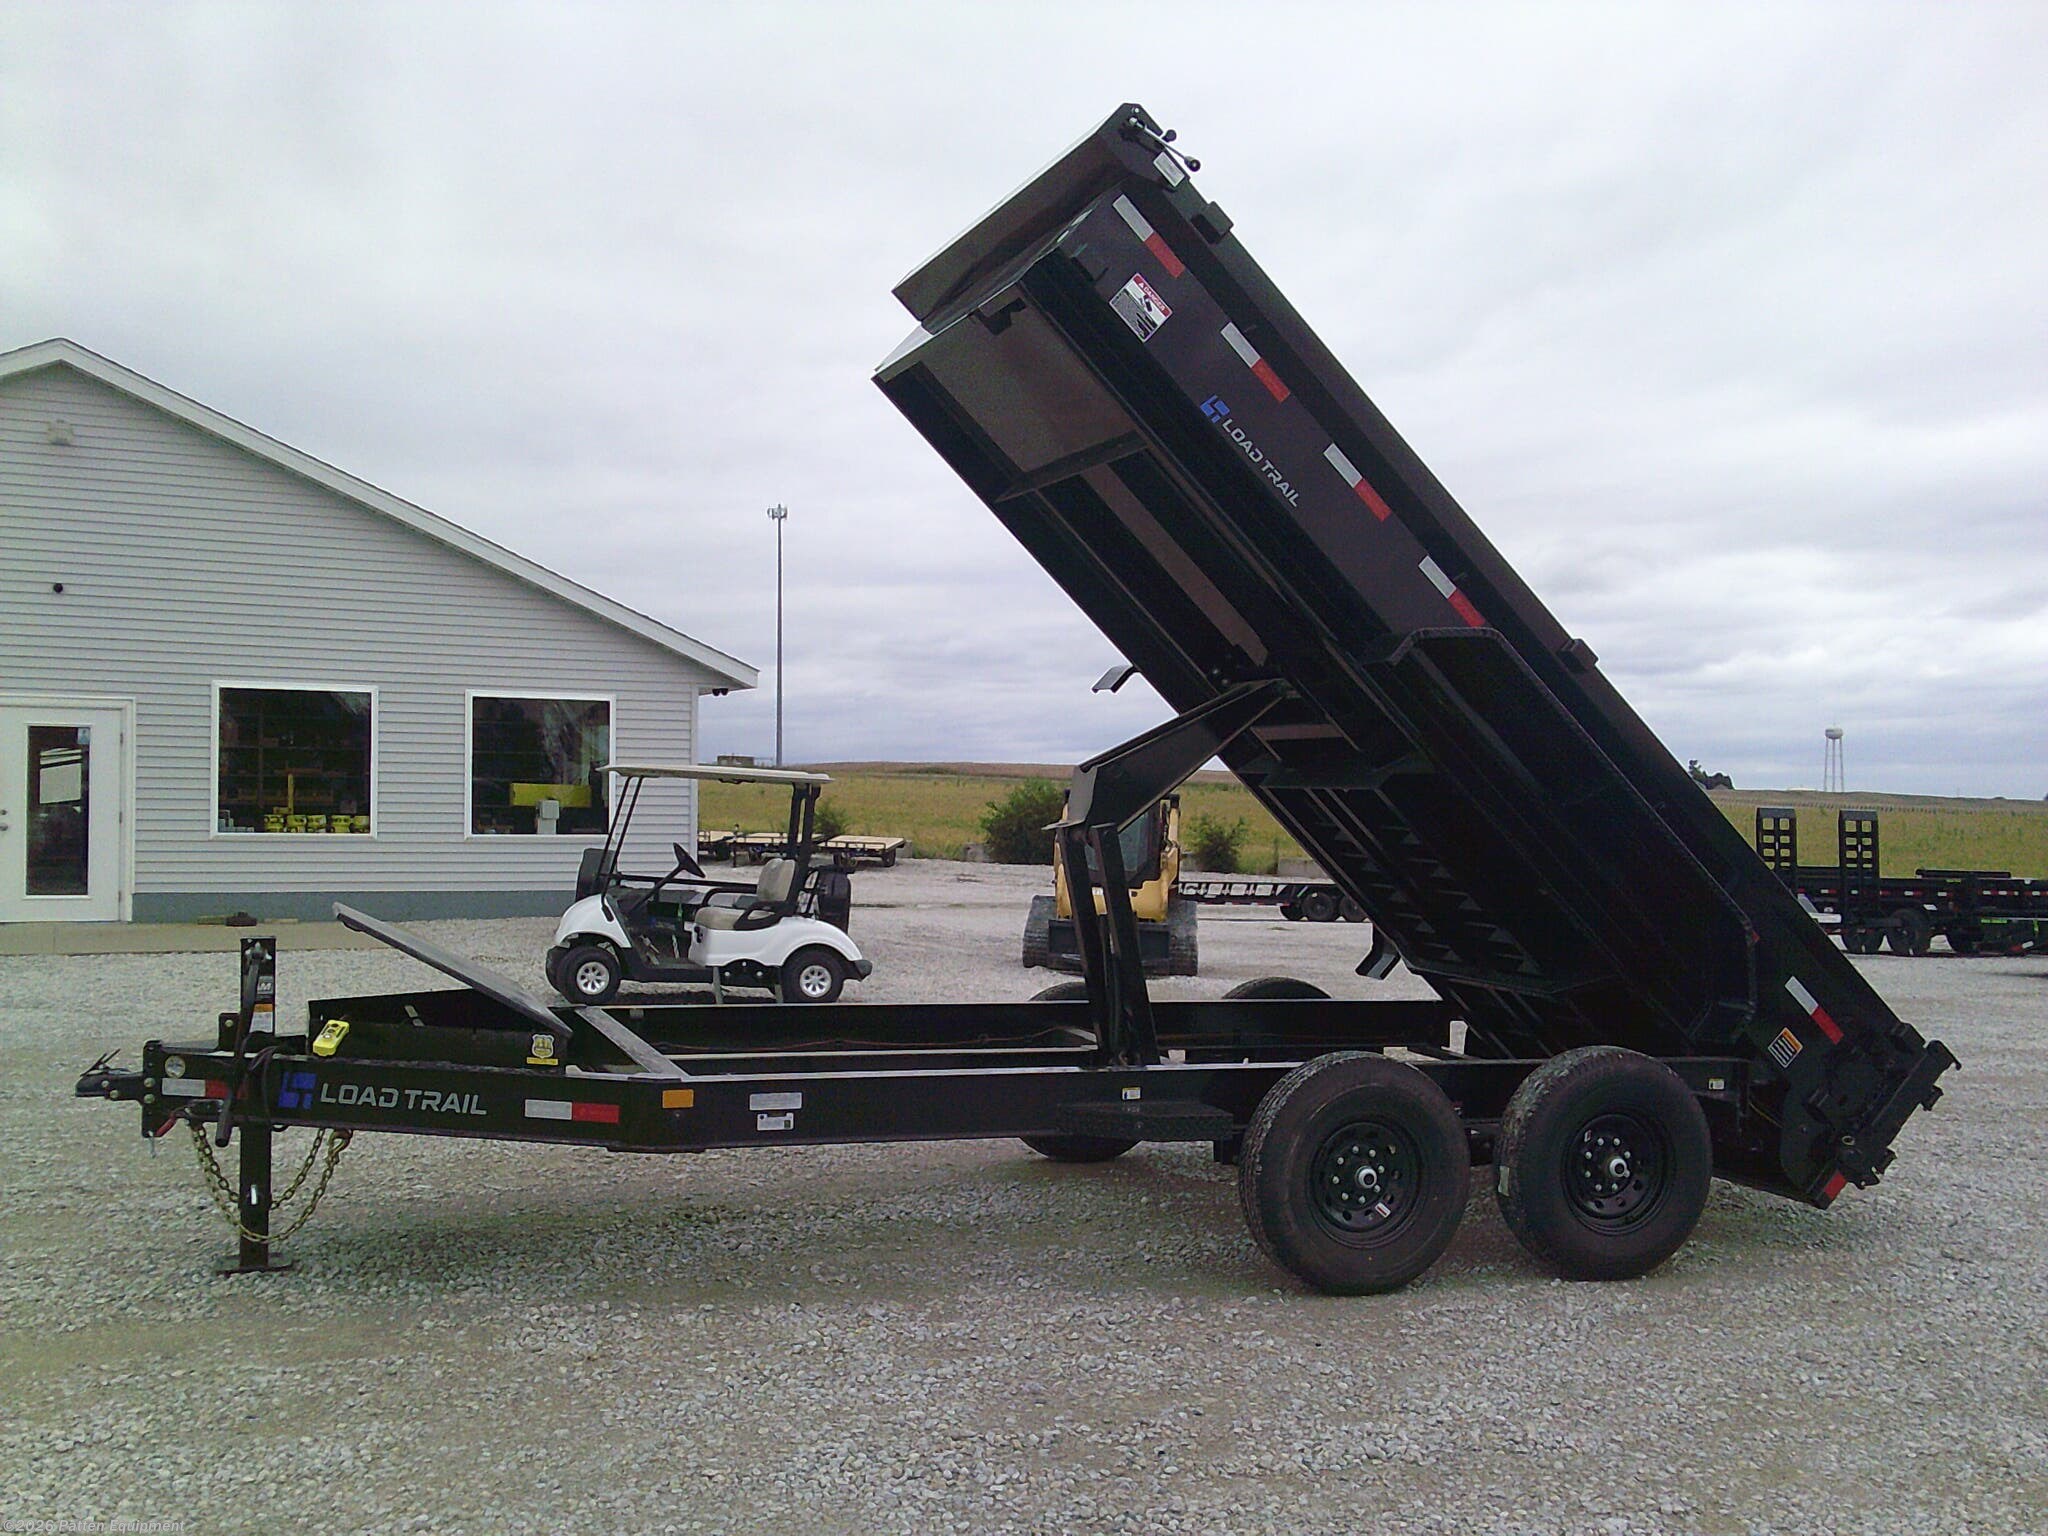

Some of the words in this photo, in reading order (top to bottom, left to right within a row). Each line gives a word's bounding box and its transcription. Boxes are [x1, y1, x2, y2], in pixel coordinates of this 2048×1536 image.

[1222, 419, 1264, 463] LOAD
[1261, 460, 1299, 507] TRAIL
[320, 1083, 400, 1108] LOAD
[404, 1089, 487, 1115] TRAIL
